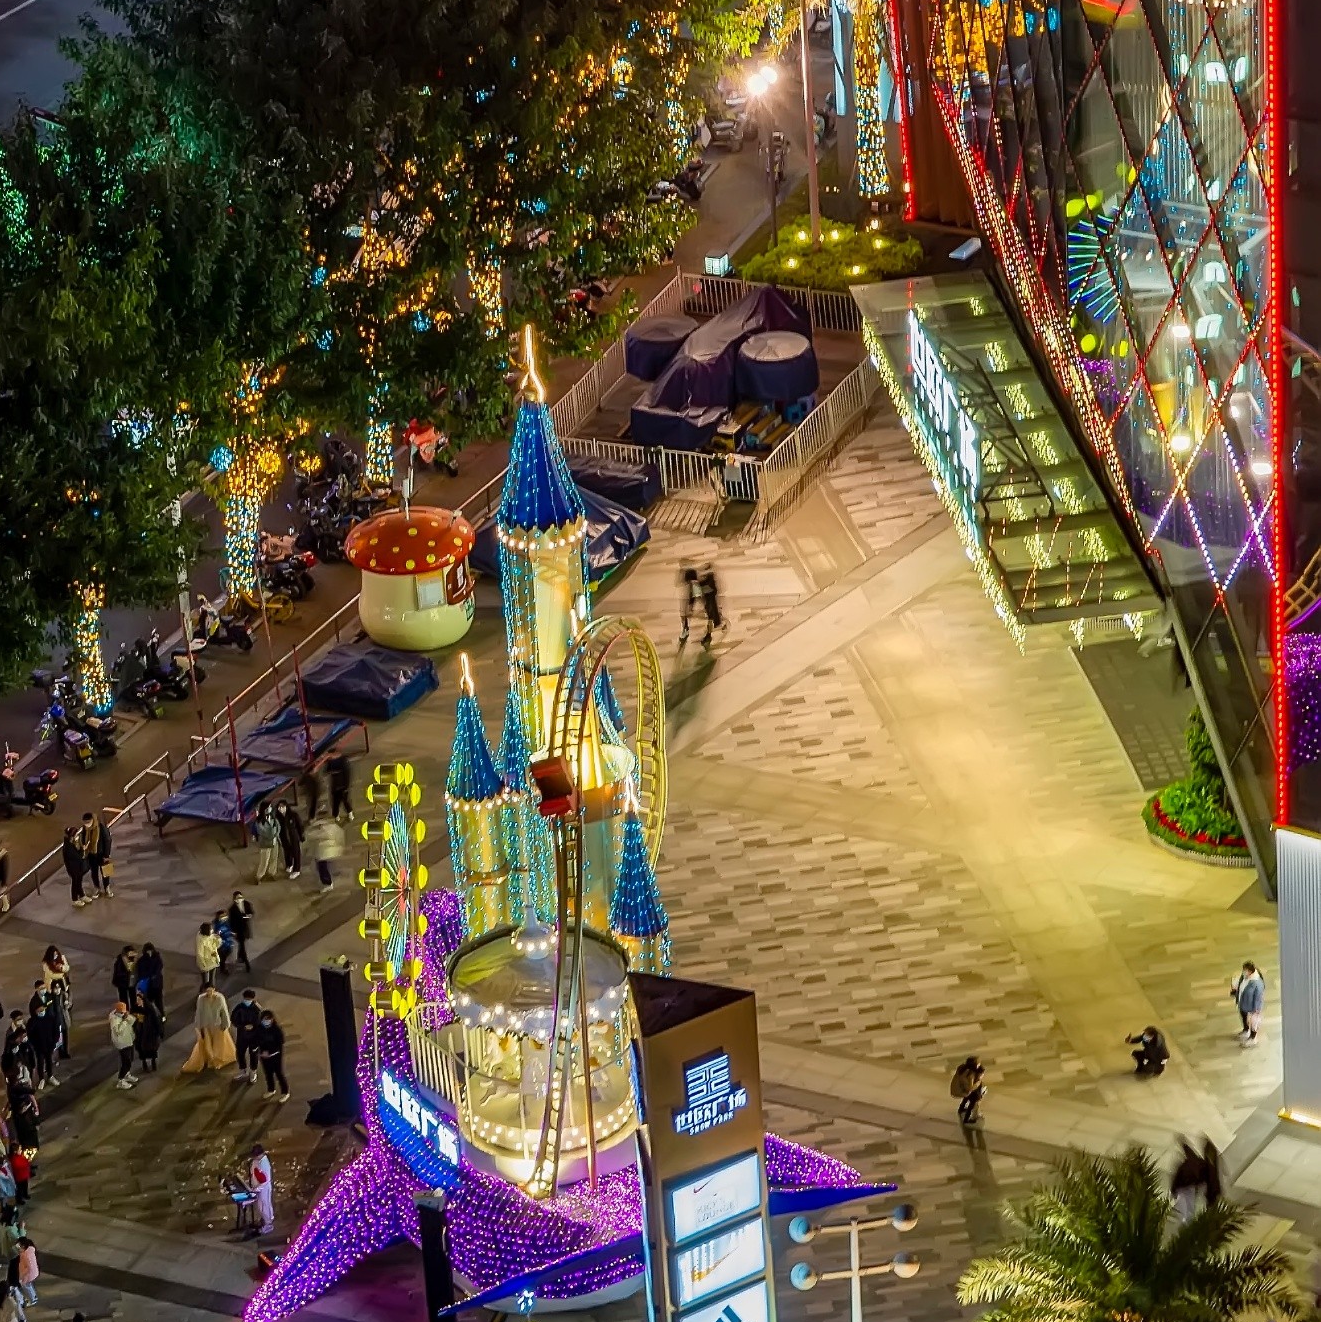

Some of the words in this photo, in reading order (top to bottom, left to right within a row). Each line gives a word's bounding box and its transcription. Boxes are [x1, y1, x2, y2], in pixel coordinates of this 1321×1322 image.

[675, 1087, 747, 1134] 世欧广场
[689, 1119, 711, 1136] SHOW
[712, 1110, 734, 1127] PARK
